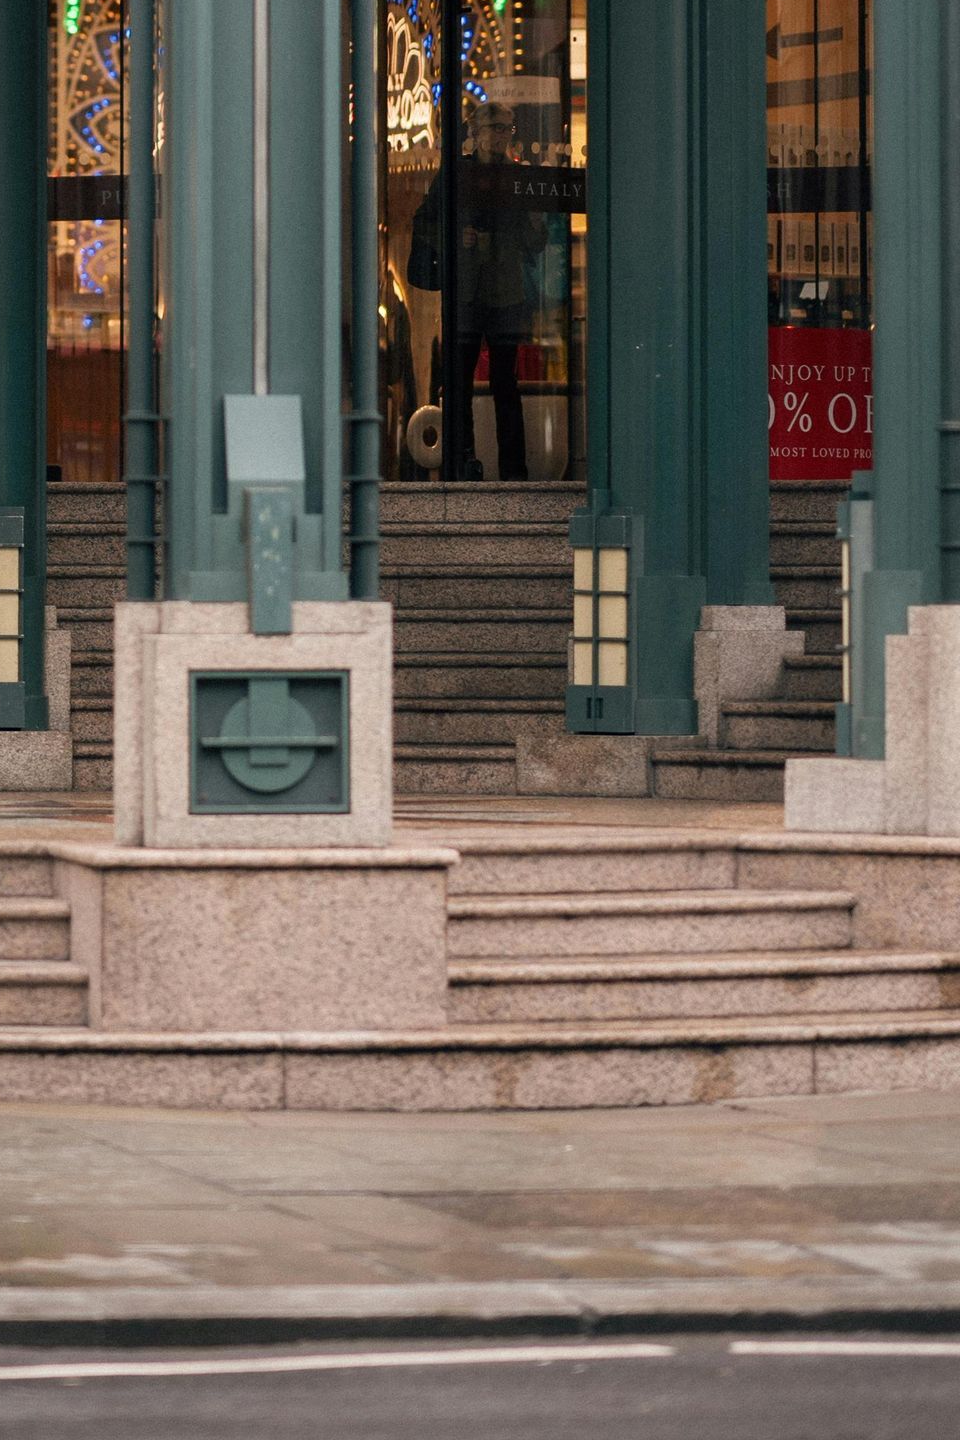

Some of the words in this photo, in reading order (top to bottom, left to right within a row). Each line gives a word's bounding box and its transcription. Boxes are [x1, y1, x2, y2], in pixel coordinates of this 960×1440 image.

[514, 181, 582, 197] EATALY
[834, 366, 855, 382] UP
[770, 447, 807, 458] MOST
[812, 447, 850, 458] LOVED
